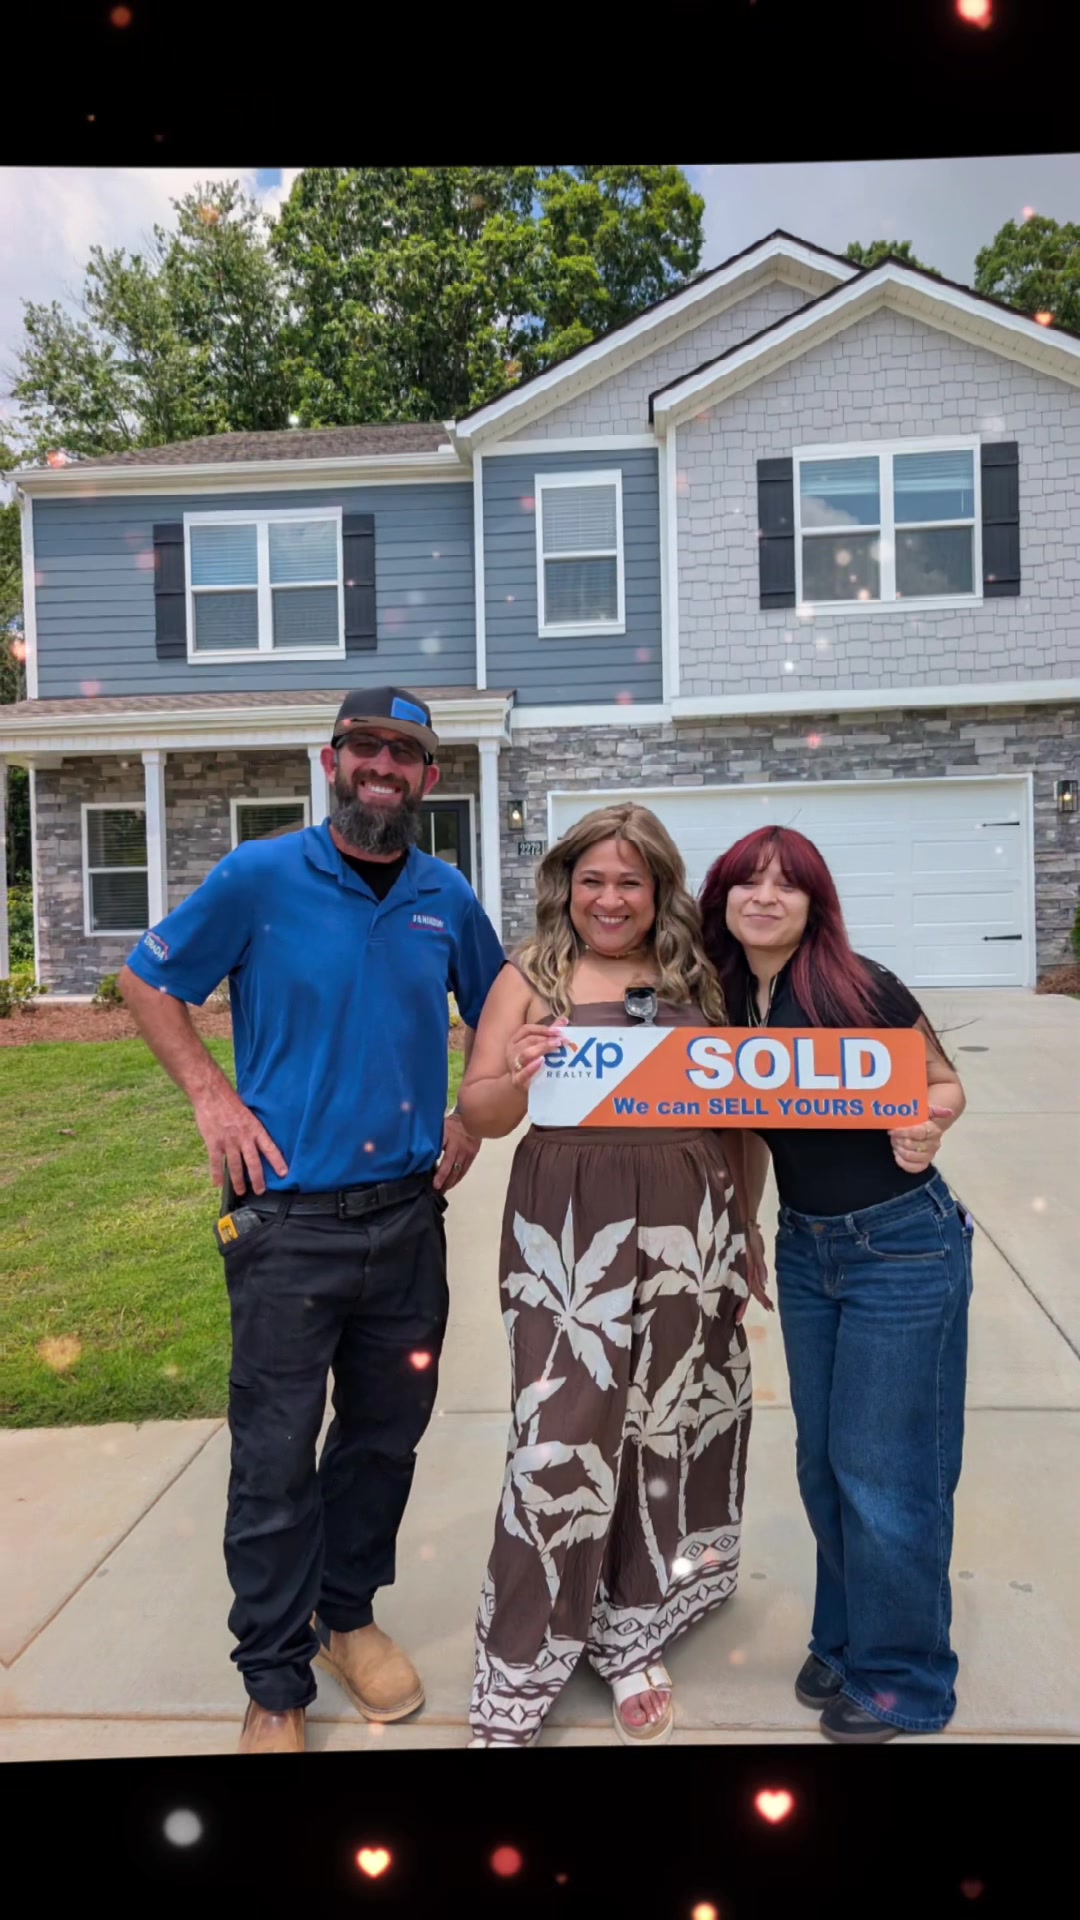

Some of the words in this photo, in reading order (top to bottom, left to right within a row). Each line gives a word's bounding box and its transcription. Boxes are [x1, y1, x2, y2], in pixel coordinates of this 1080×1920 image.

[520, 842, 542, 856] 2272
[685, 1036, 892, 1090] SOLD
[613, 1097, 649, 1115] We
[657, 1101, 700, 1115] can
[708, 1098, 769, 1115] SELL
[777, 1098, 864, 1116] YOURS
[872, 1099, 919, 1116] too!
